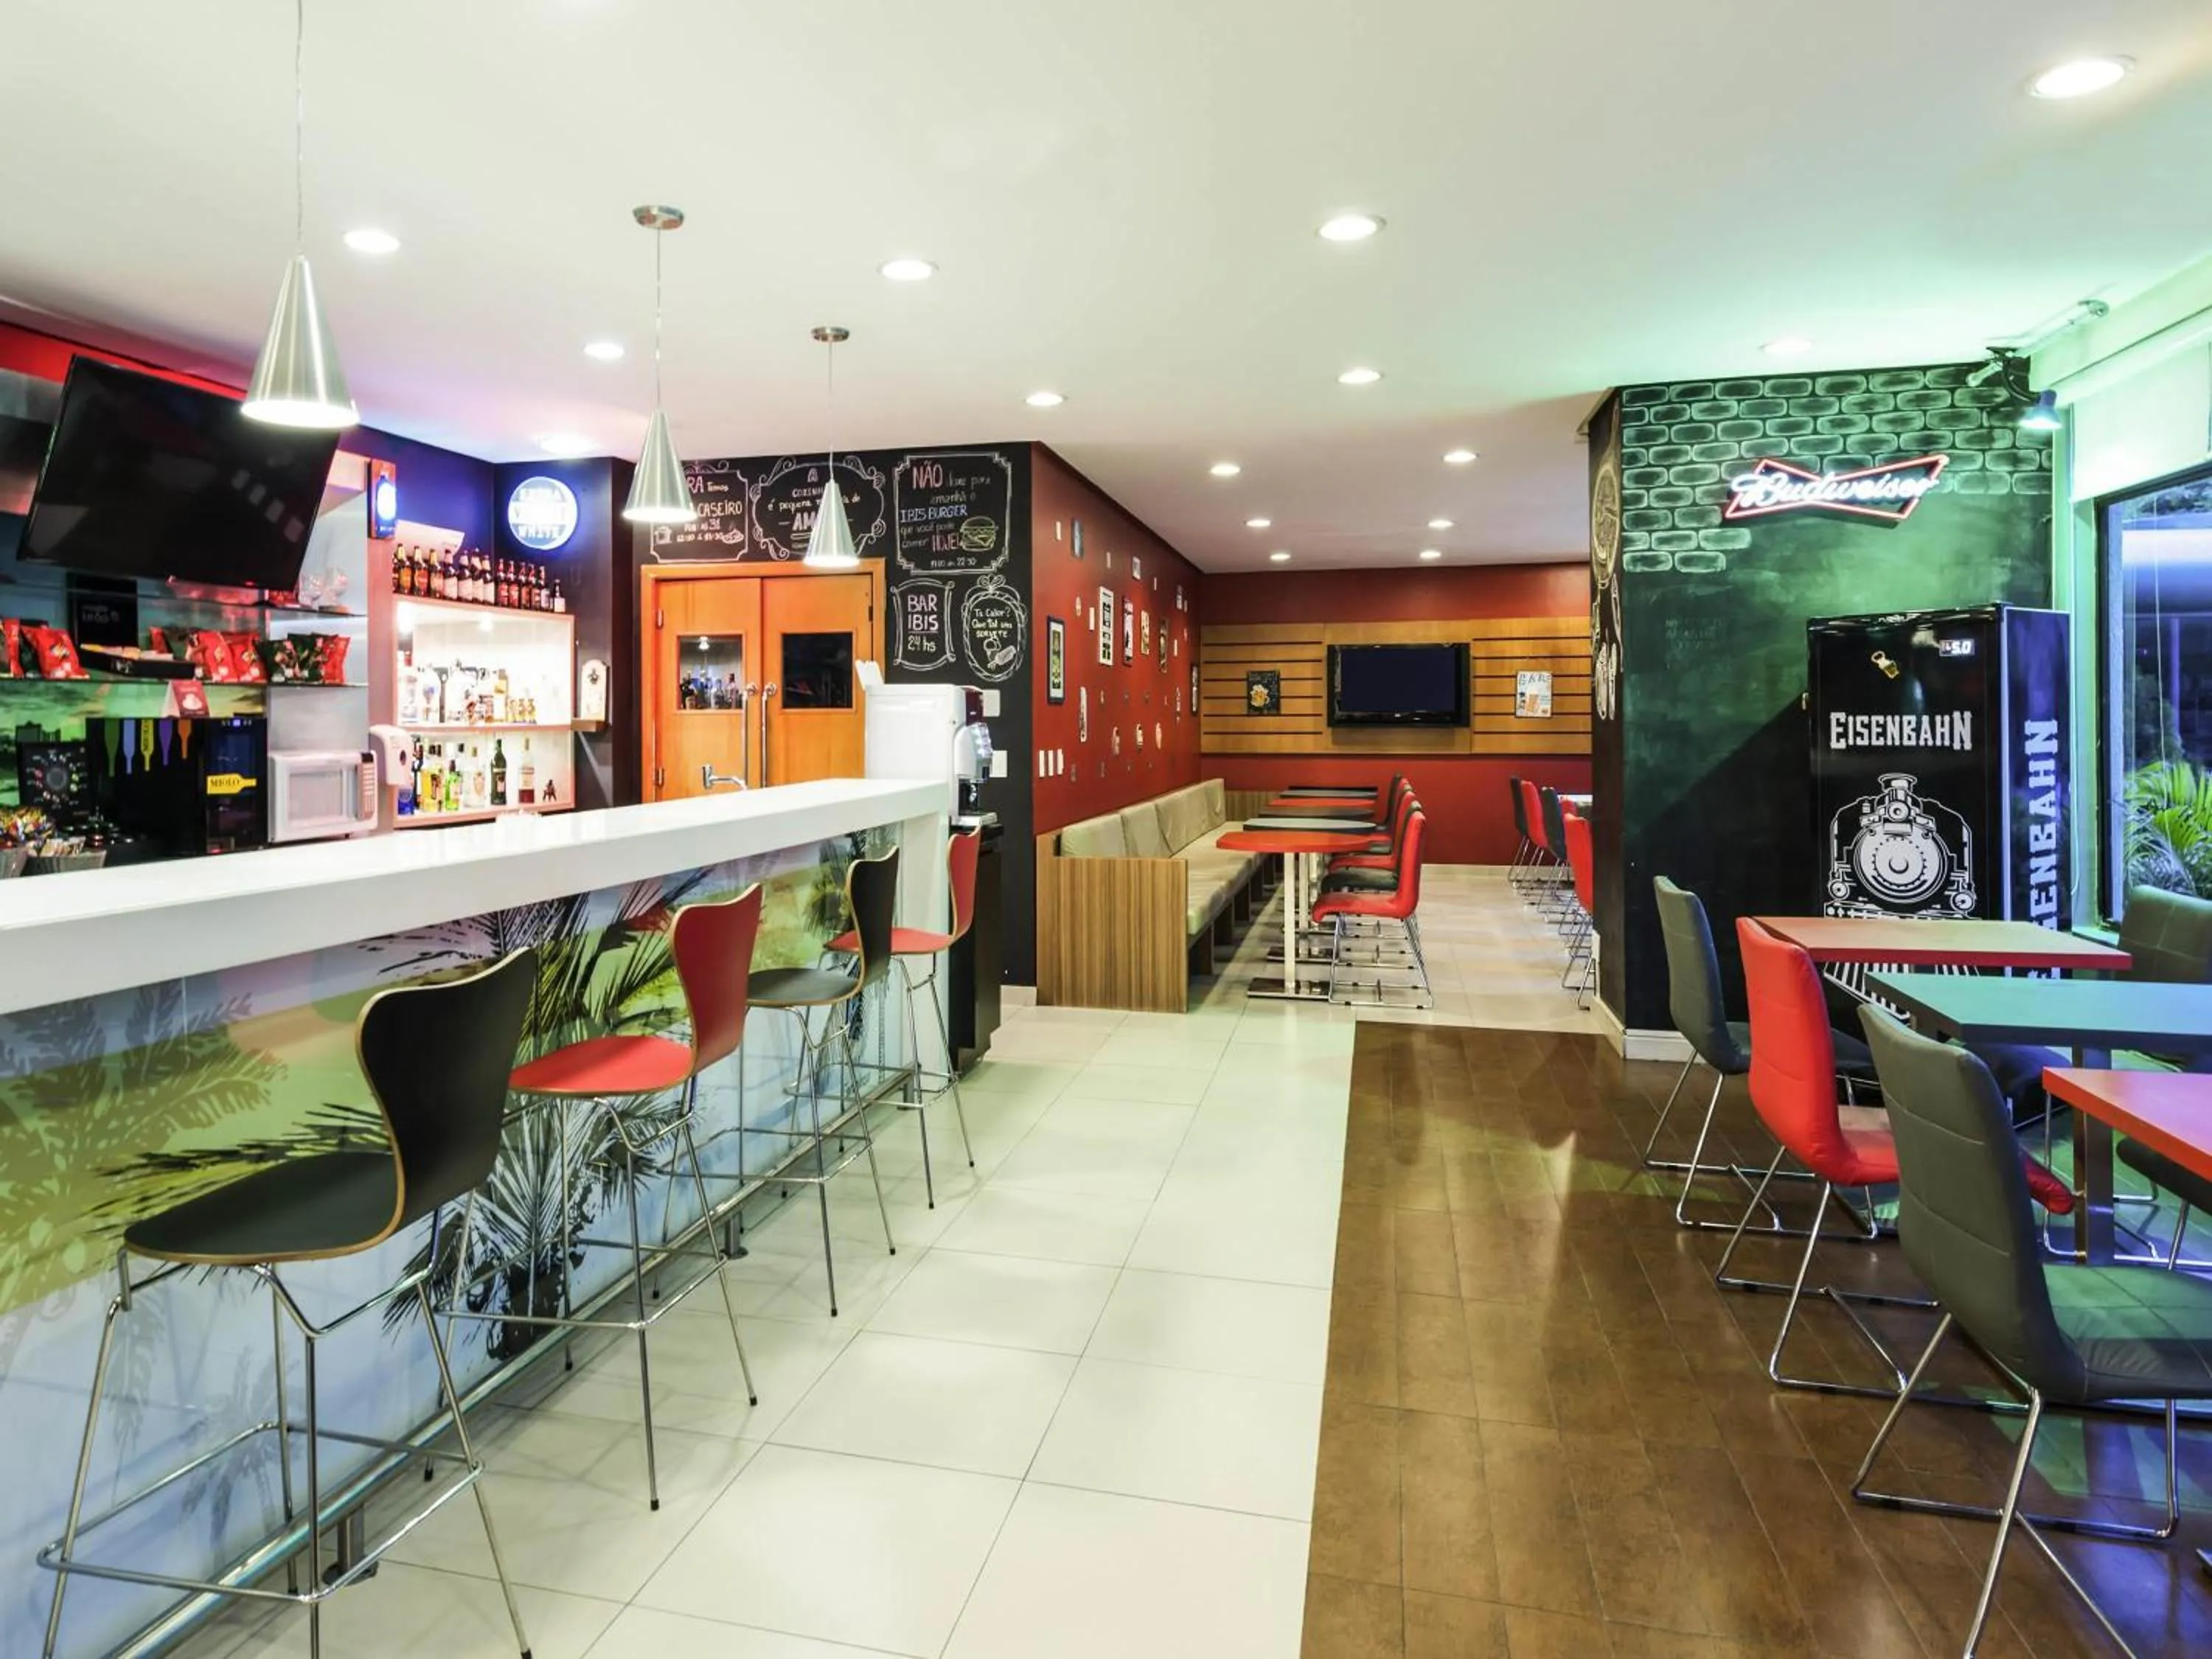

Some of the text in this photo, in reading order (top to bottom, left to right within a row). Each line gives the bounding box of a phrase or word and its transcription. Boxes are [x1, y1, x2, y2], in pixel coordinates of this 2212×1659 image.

[912, 461, 943, 490] NÃO
[1731, 472, 1939, 507] Budweiser
[928, 504, 967, 520] BURGER
[908, 594, 937, 613] BAR
[908, 613, 938, 630] IBIS
[908, 635, 921, 651] 24
[1829, 710, 1972, 750] EISENBAHN
[2024, 719, 2059, 931] ENBAHN
